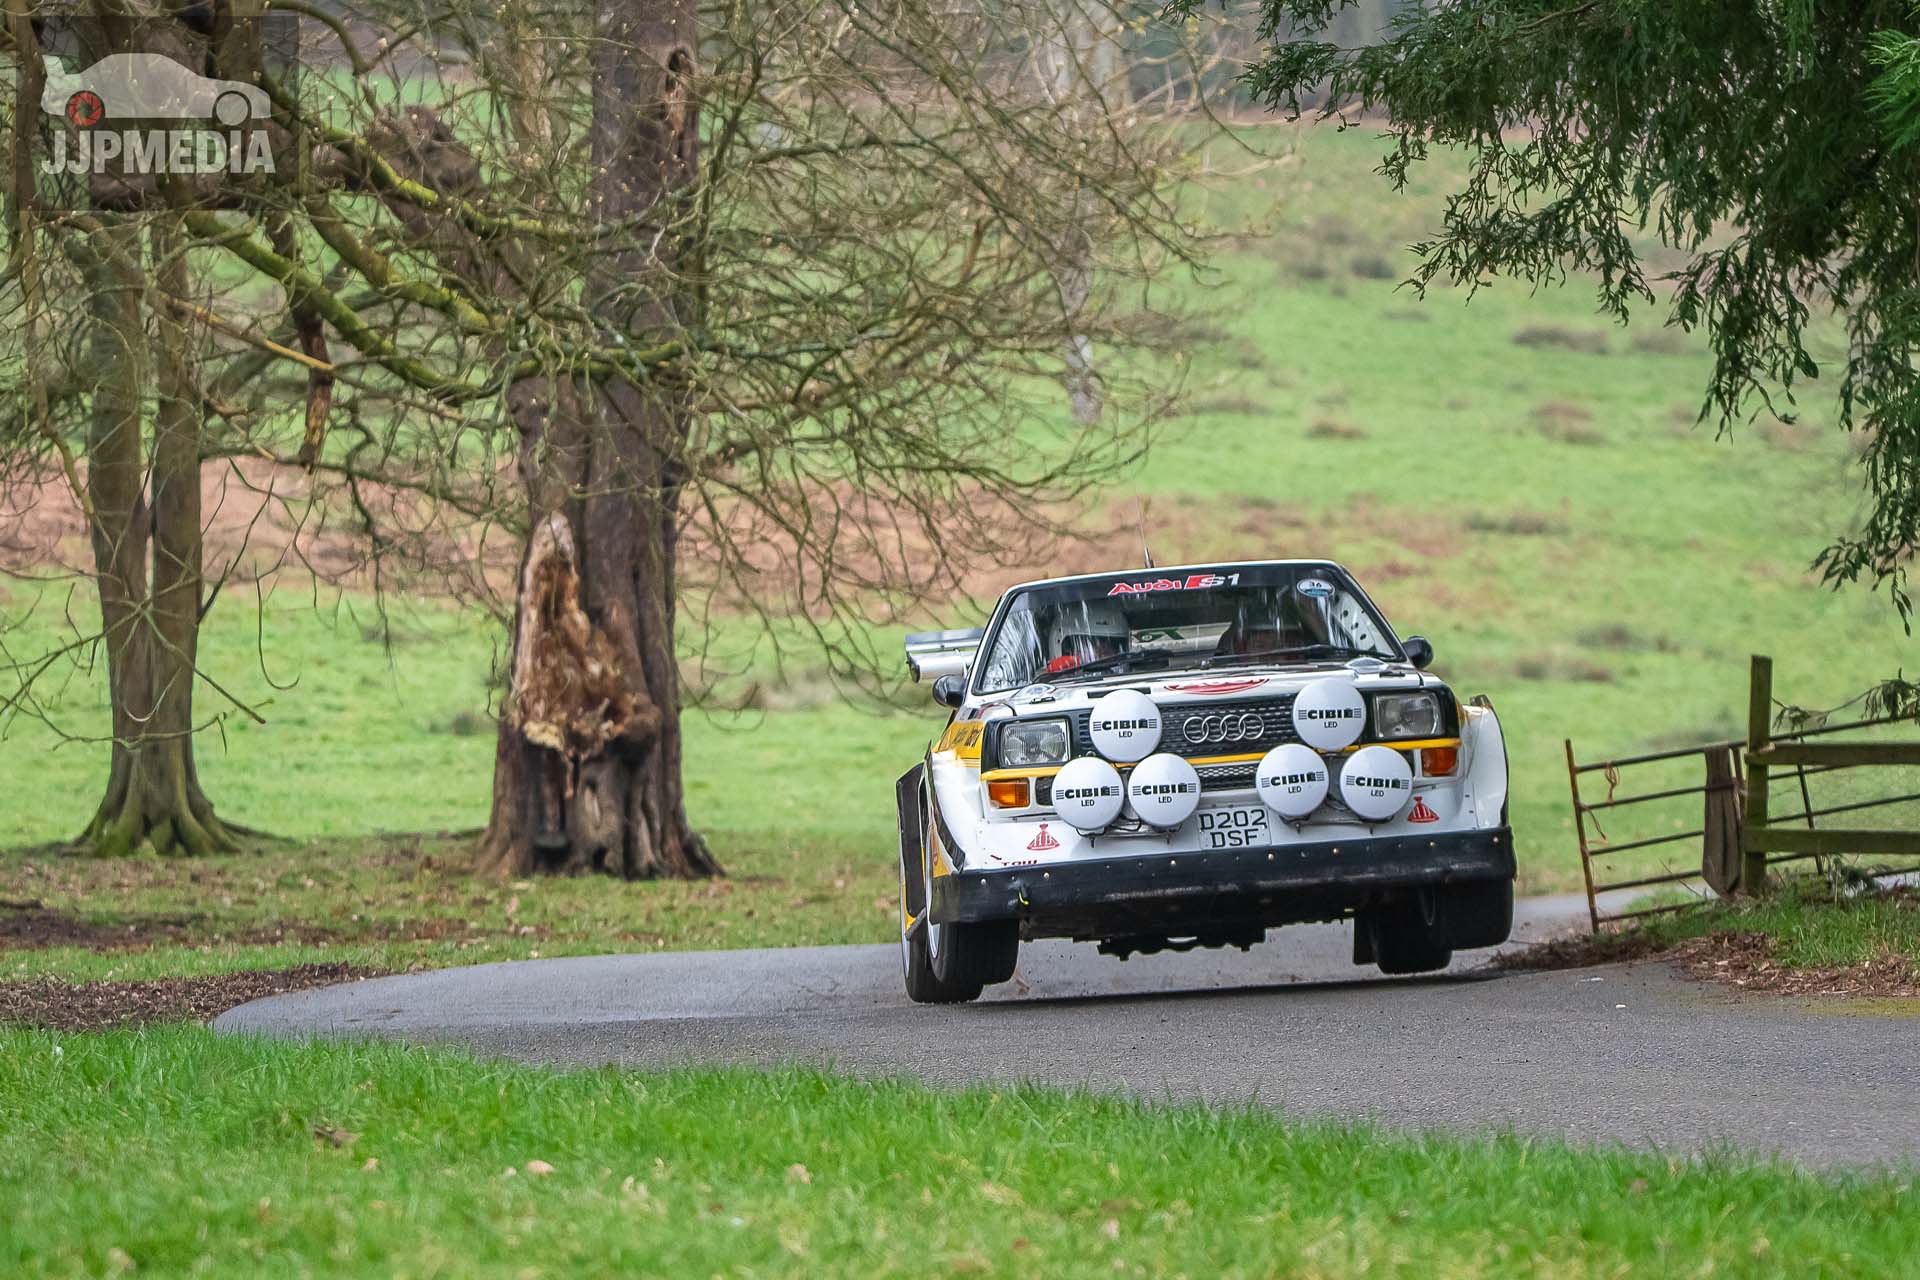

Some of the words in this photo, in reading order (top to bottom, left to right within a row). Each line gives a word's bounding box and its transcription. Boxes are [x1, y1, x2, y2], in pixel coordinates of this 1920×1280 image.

[1324, 721, 1338, 729] LED
[1288, 786, 1302, 794] LED
[1370, 789, 1384, 797] LED
[1081, 799, 1095, 807] LED
[1158, 796, 1172, 804] LED
[1199, 809, 1267, 830] D202
[1210, 828, 1258, 848] DSF
